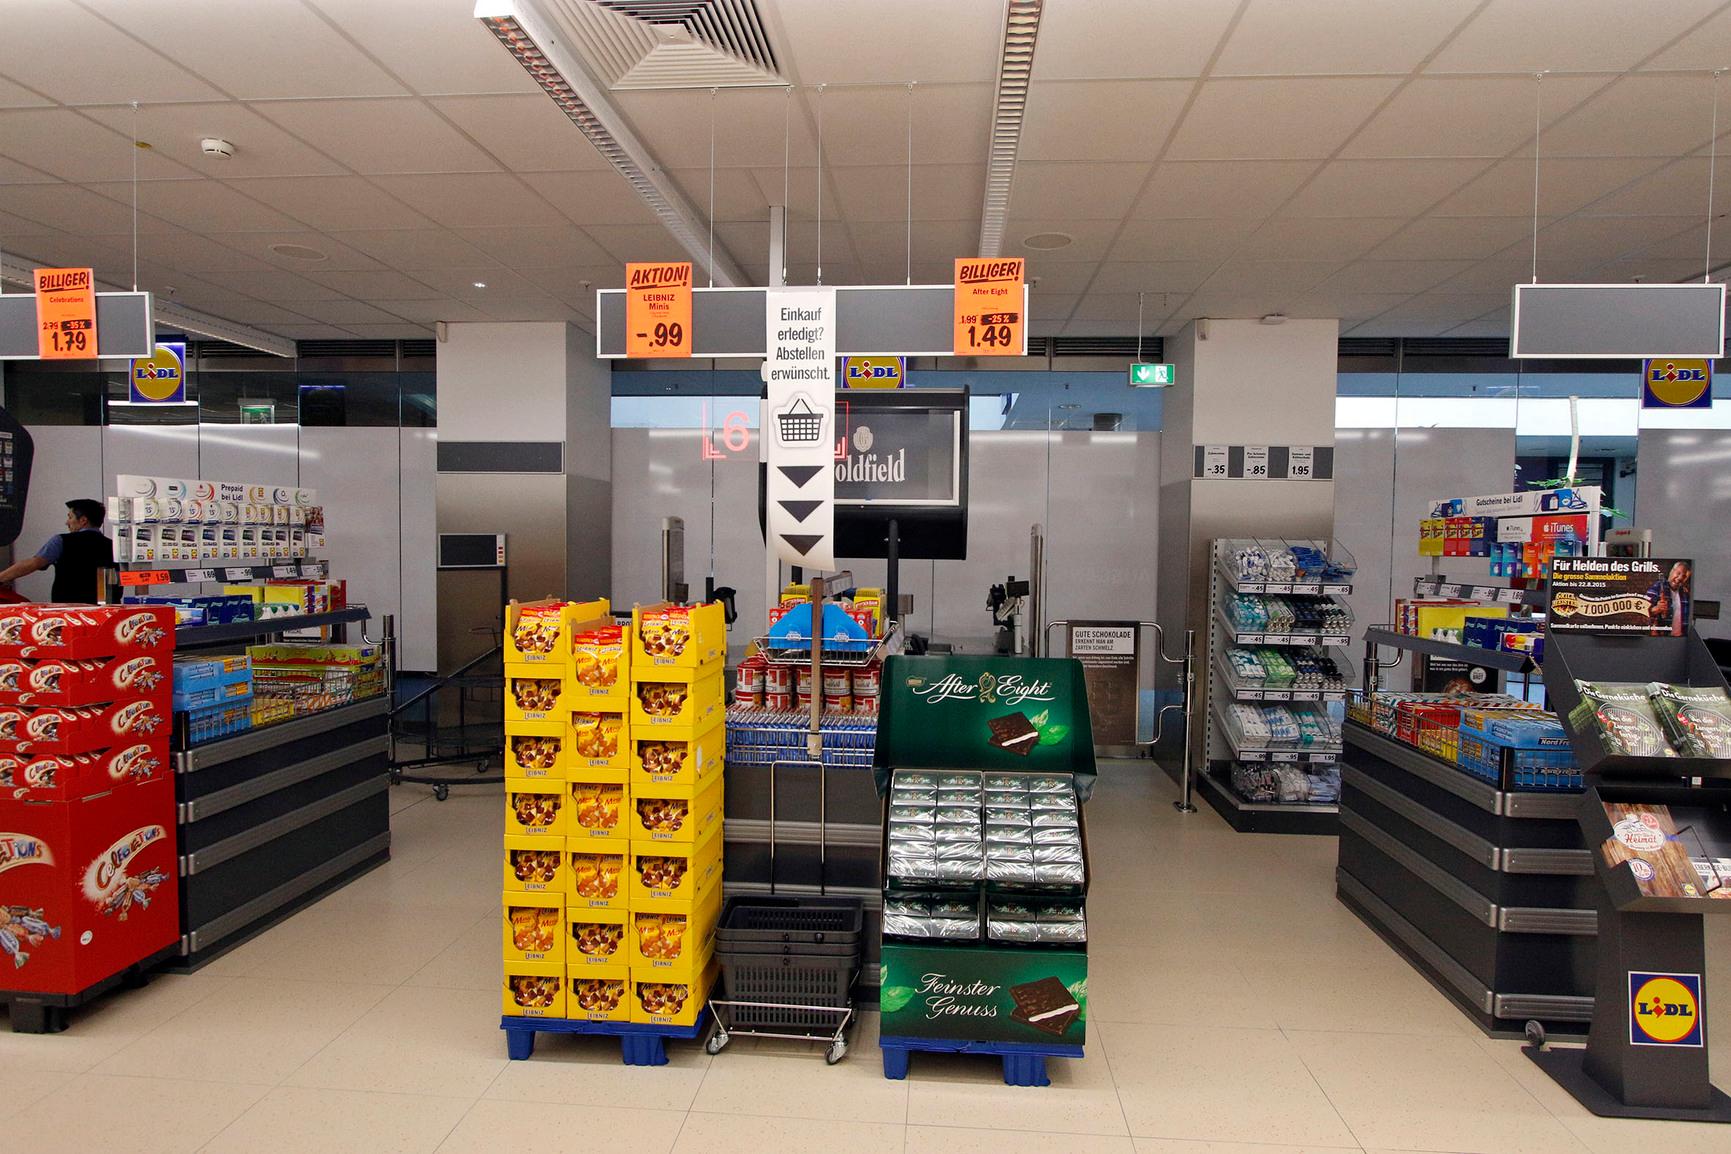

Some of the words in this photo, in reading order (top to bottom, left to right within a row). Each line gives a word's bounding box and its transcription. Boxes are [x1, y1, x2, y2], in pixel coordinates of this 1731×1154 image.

[631, 266, 689, 286] AKTION!
[960, 262, 1021, 281] BILLIGER!
[40, 272, 90, 290] BILLIGER!
[991, 288, 1008, 296] Eight
[780, 307, 822, 321] Einkauf
[636, 322, 682, 346] -.99
[777, 326, 824, 344] erledigt?
[968, 326, 1012, 347] 1.49
[52, 331, 86, 352] 1.79
[776, 346, 825, 361] Abstellen
[771, 366, 830, 380] erwünscht.
[722, 411, 750, 452] 6
[834, 448, 906, 482] oldfield
[1207, 465, 1226, 474] -.35
[1246, 466, 1266, 474] -.85
[1292, 466, 1310, 475] 1.95
[221, 484, 244, 492] Prepaid
[232, 493, 244, 501] Lidl
[1476, 497, 1502, 506] Gutscheine
[1503, 496, 1512, 504] bei
[1550, 522, 1574, 532] iTunes
[1553, 560, 1570, 570] Für
[1572, 560, 1608, 571] Helden
[1610, 562, 1630, 572] des
[1632, 561, 1660, 572] Grills.
[1075, 630, 1090, 638] GUTE
[1092, 630, 1131, 638] SCHOKOLADE
[912, 673, 978, 704] After
[996, 675, 1056, 706] Eight
[1624, 833, 1656, 844] Heimat
[914, 972, 1000, 996] Feinster
[925, 996, 998, 1020] Genuss
